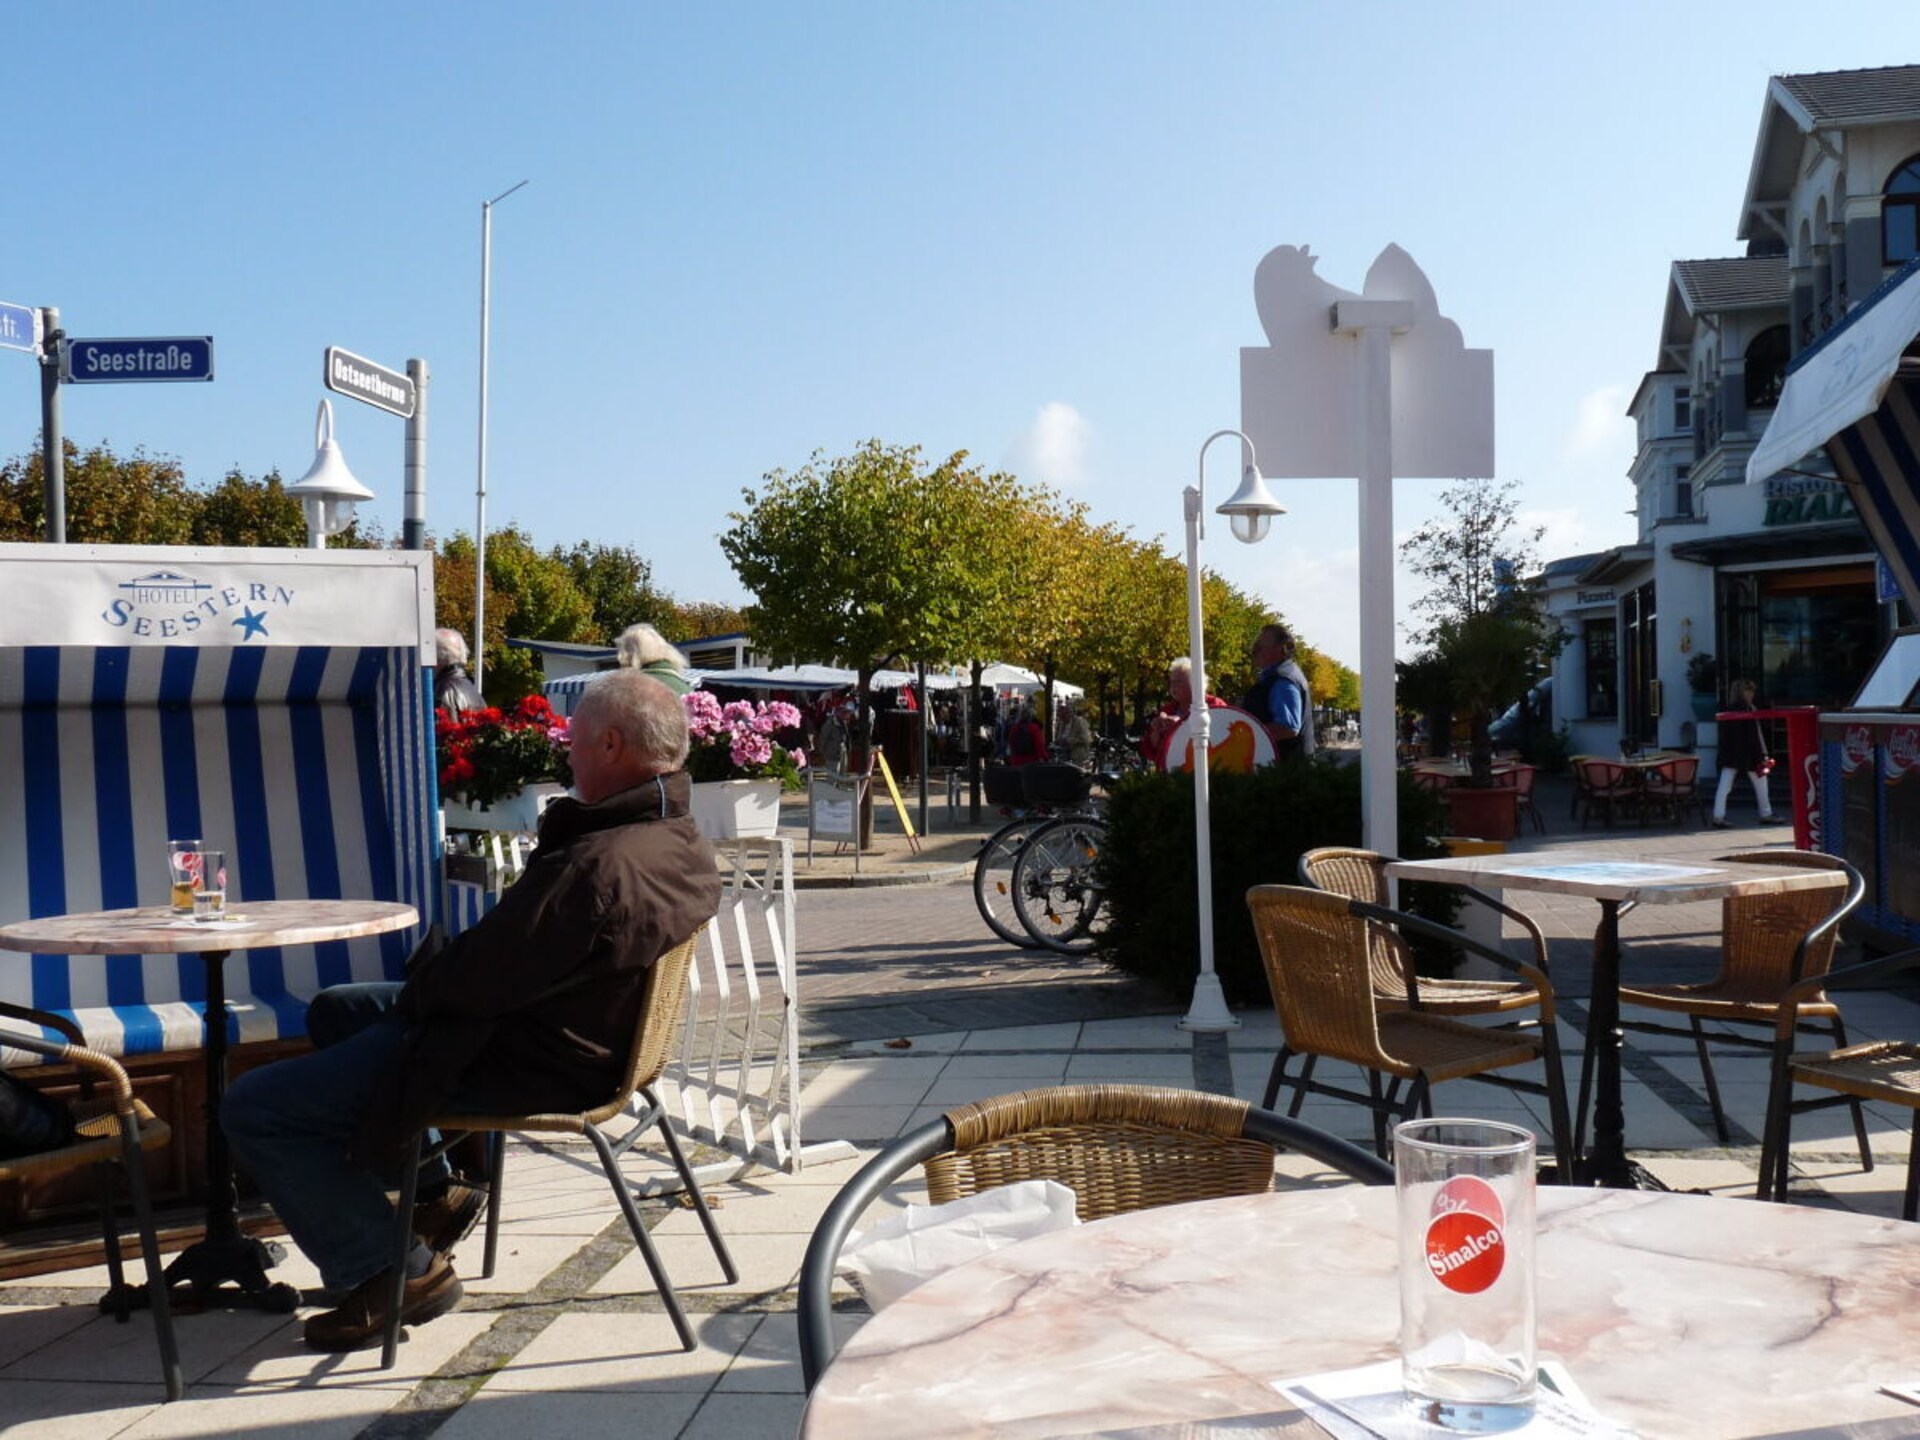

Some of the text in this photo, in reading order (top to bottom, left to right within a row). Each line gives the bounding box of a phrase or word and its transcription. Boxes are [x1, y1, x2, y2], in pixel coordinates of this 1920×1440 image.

[86, 345, 193, 372] Seestraße
[335, 357, 406, 404] Ostseetherme
[102, 583, 295, 638] SEESTERN
[138, 587, 194, 604] HOTEL
[1428, 1229, 1500, 1276] Sinalco
